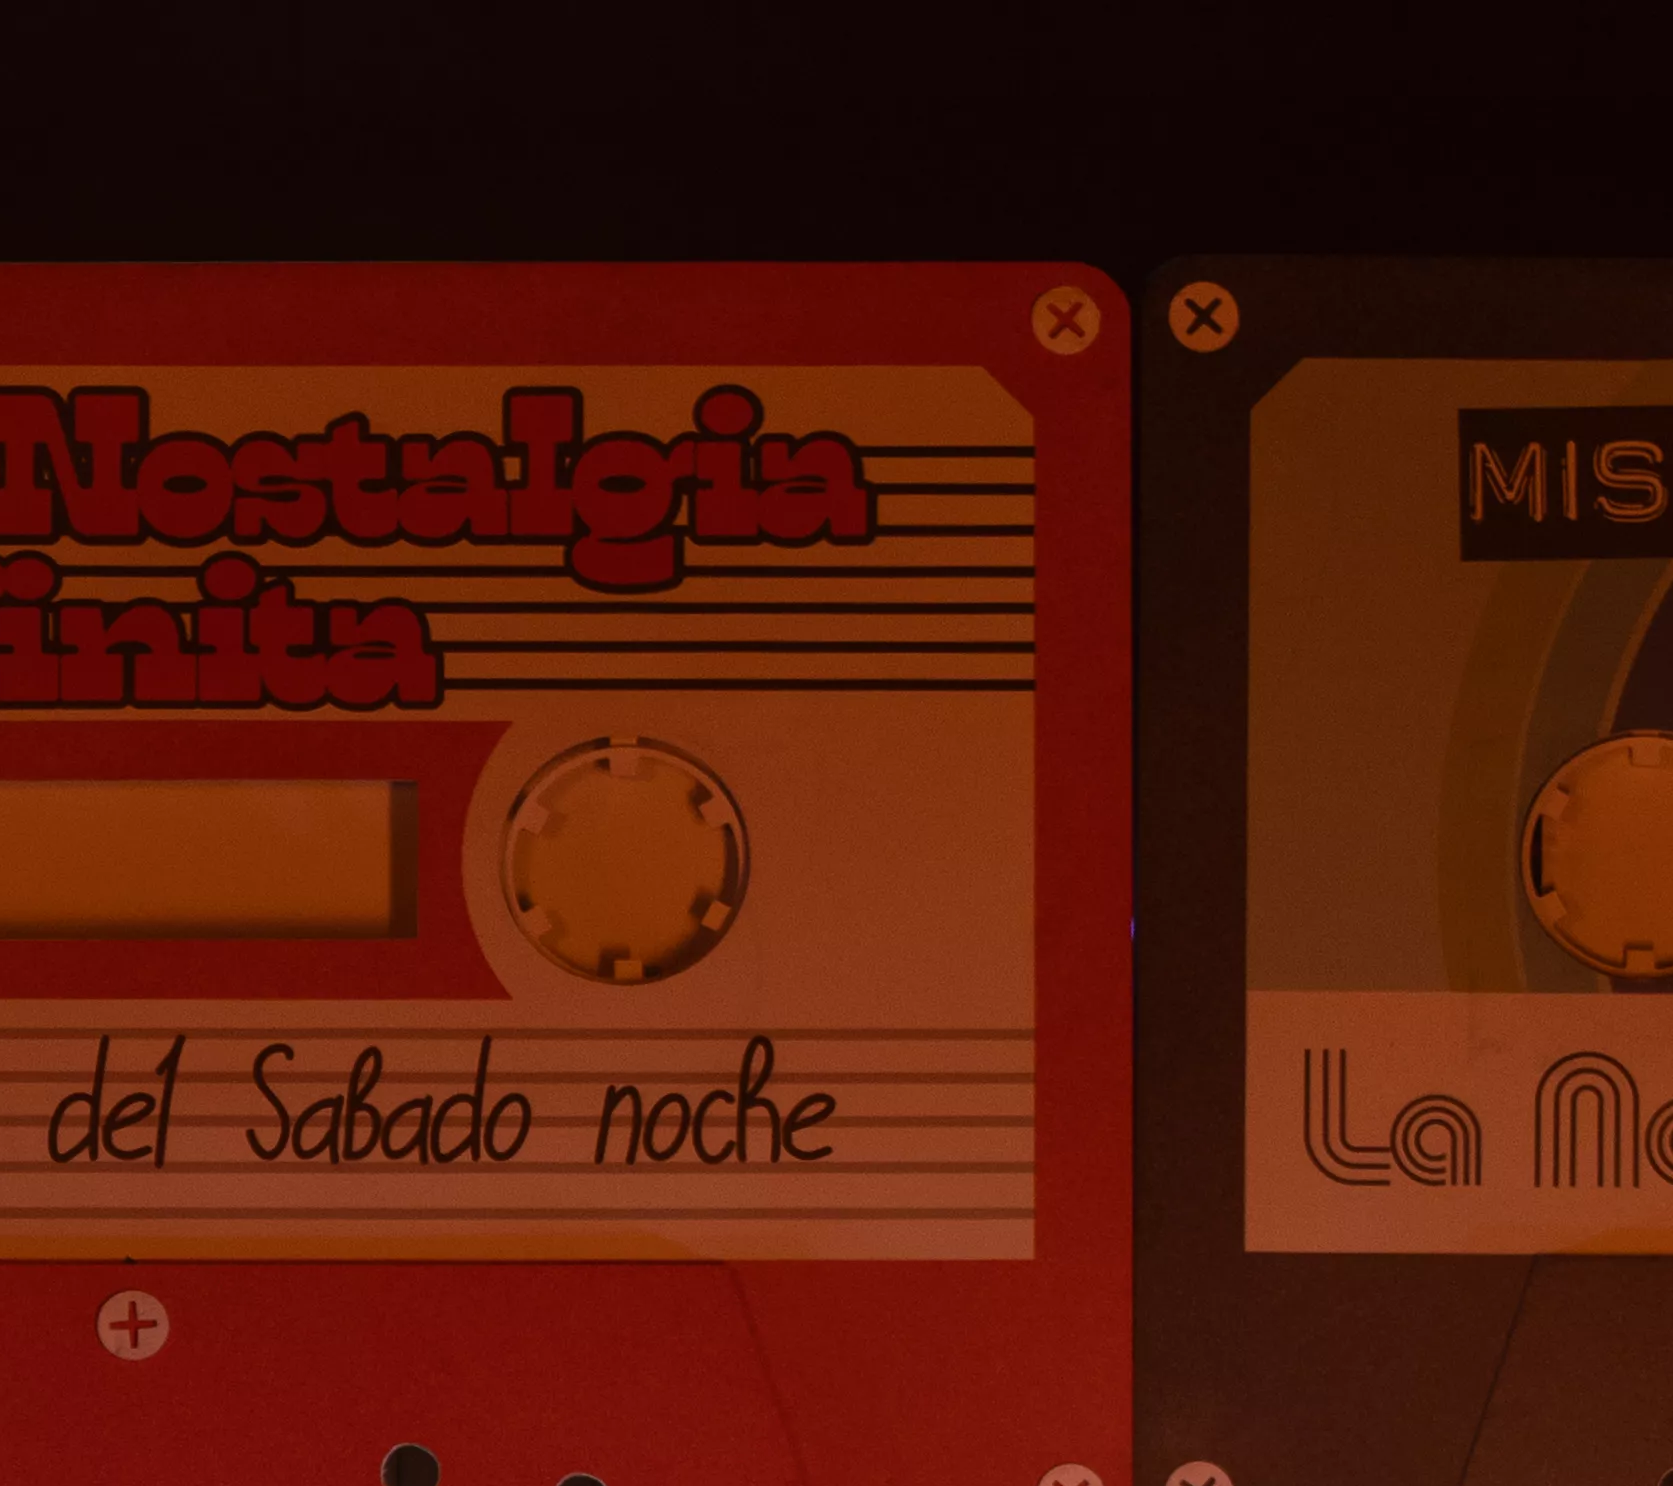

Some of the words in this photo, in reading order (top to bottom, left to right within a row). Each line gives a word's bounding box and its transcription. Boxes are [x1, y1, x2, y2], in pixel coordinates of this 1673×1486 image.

[1468, 437, 1668, 523] MIS
[47, 1036, 187, 1167] del
[245, 1036, 533, 1167] Sabado
[595, 1035, 837, 1166] noche
[1301, 1047, 1483, 1188] La
